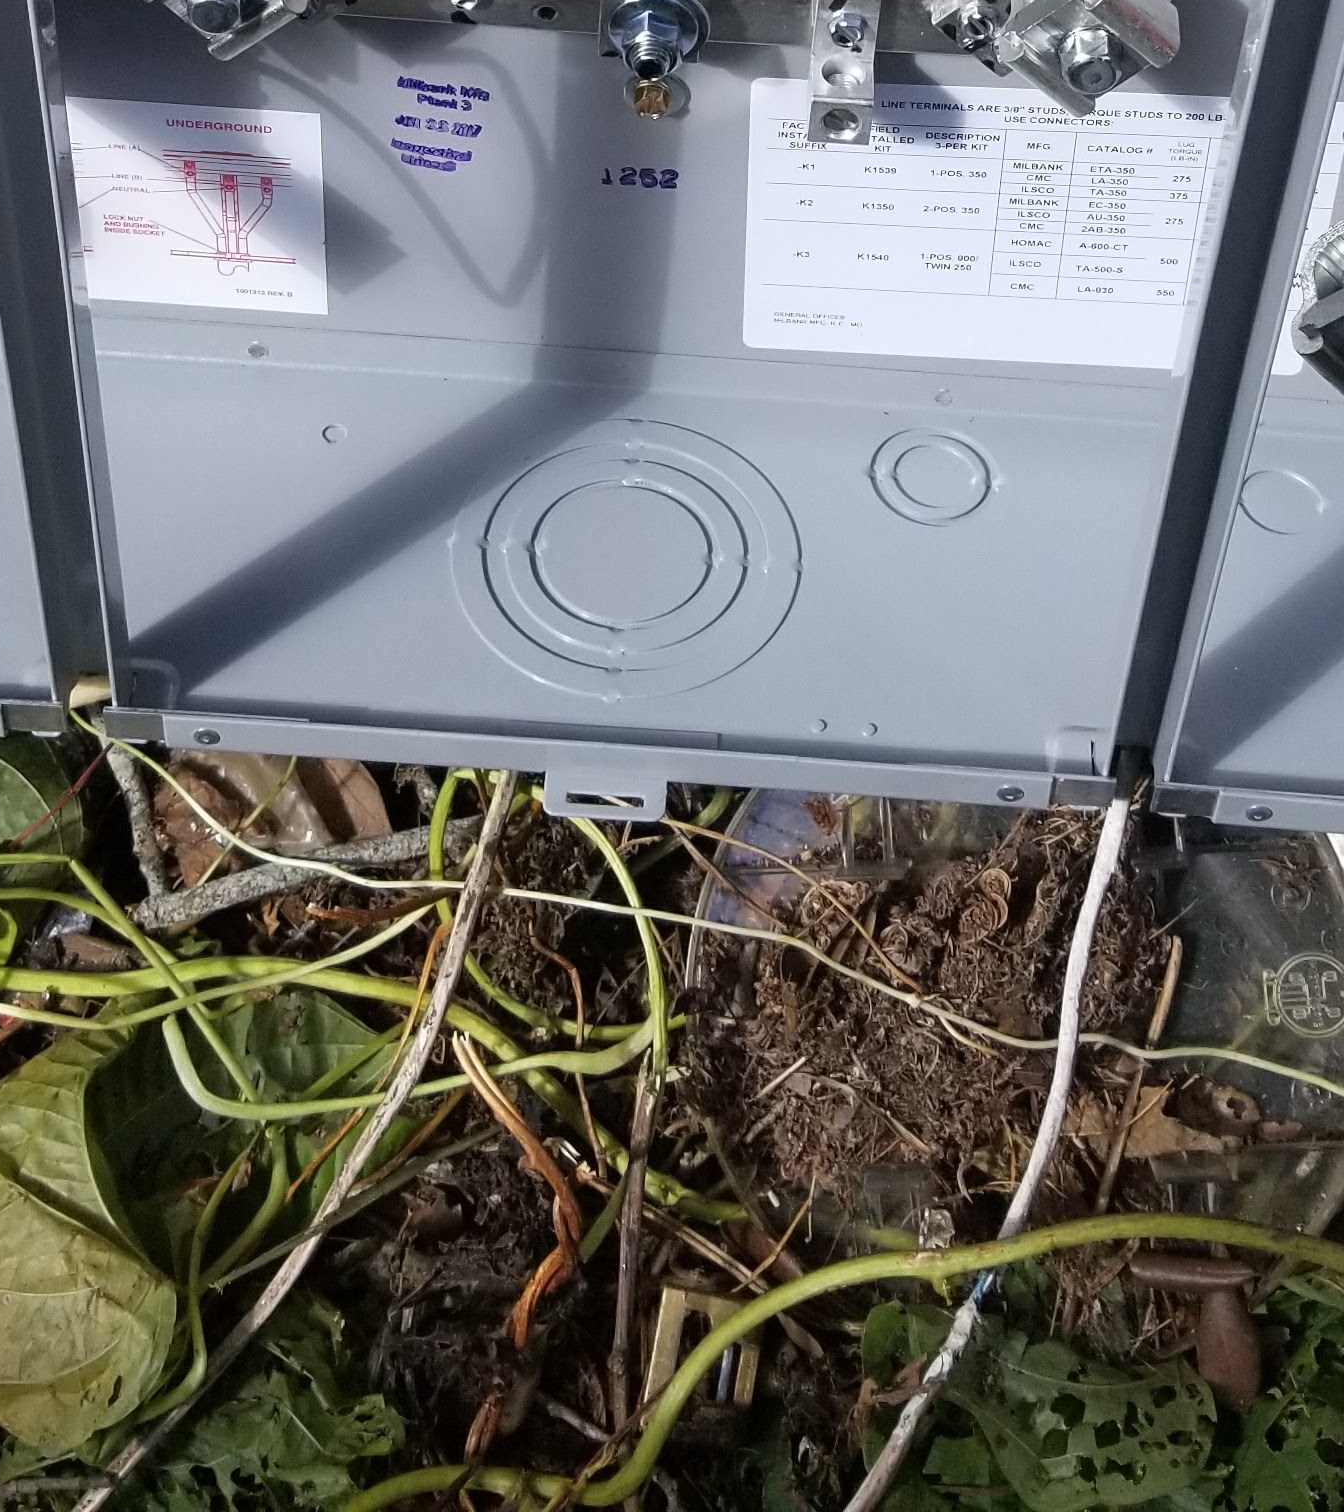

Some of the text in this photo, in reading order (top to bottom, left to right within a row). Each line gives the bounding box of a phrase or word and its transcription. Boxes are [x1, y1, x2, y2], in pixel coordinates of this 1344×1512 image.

[881, 100, 907, 109] LINE
[910, 102, 974, 112] TERMINALS
[977, 104, 1001, 113] ARE
[1028, 106, 1068, 116] STUDS,
[1125, 110, 1164, 120] STUDS
[1167, 112, 1183, 120] TO
[1185, 113, 1205, 121] 200
[165, 118, 273, 134] UNDERGROUND
[1004, 116, 1114, 127] USE CONNECTORS:
[926, 132, 1001, 142] DESCRIPTION
[789, 142, 827, 150] SUFFIX
[935, 142, 967, 151] 3-PER
[1026, 143, 1053, 151] MFG.
[1087, 146, 1143, 154] CATALOG
[1168, 148, 1203, 156] TORQUE
[601, 166, 679, 189] 1252
[798, 163, 815, 171] -K1
[864, 166, 897, 175] K1539
[969, 171, 987, 179] 350
[1012, 162, 1064, 172] MILBANK
[1089, 166, 1136, 175] ETA-350
[1172, 175, 1191, 183] 275
[1026, 174, 1129, 186] CMC LA-350
[112, 186, 150, 194] NEUTRAL
[1020, 185, 1188, 200] ILSCO TA-350 375
[796, 199, 814, 207] -K2
[862, 202, 895, 211] K1350
[1009, 198, 1059, 207] MILBANK
[1088, 201, 1126, 210] EC-350
[127, 215, 144, 223] NUT
[1017, 211, 1184, 226] ILSCO AU-350 275
[104, 227, 166, 237] INSIDE SOCKET
[122, 222, 160, 230] BUSHING
[1019, 222, 1126, 235] CMC 2AB-350
[1011, 239, 1053, 248] HOMAC
[792, 250, 811, 258] -K3
[857, 253, 890, 262] K1540
[1008, 260, 1042, 268] ILSCO
[1075, 265, 1124, 275] TA-500-S
[1159, 257, 1179, 265] 500
[924, 262, 972, 271] TWIN 250
[1010, 283, 1035, 291] CMC
[1156, 289, 1175, 297] 550
